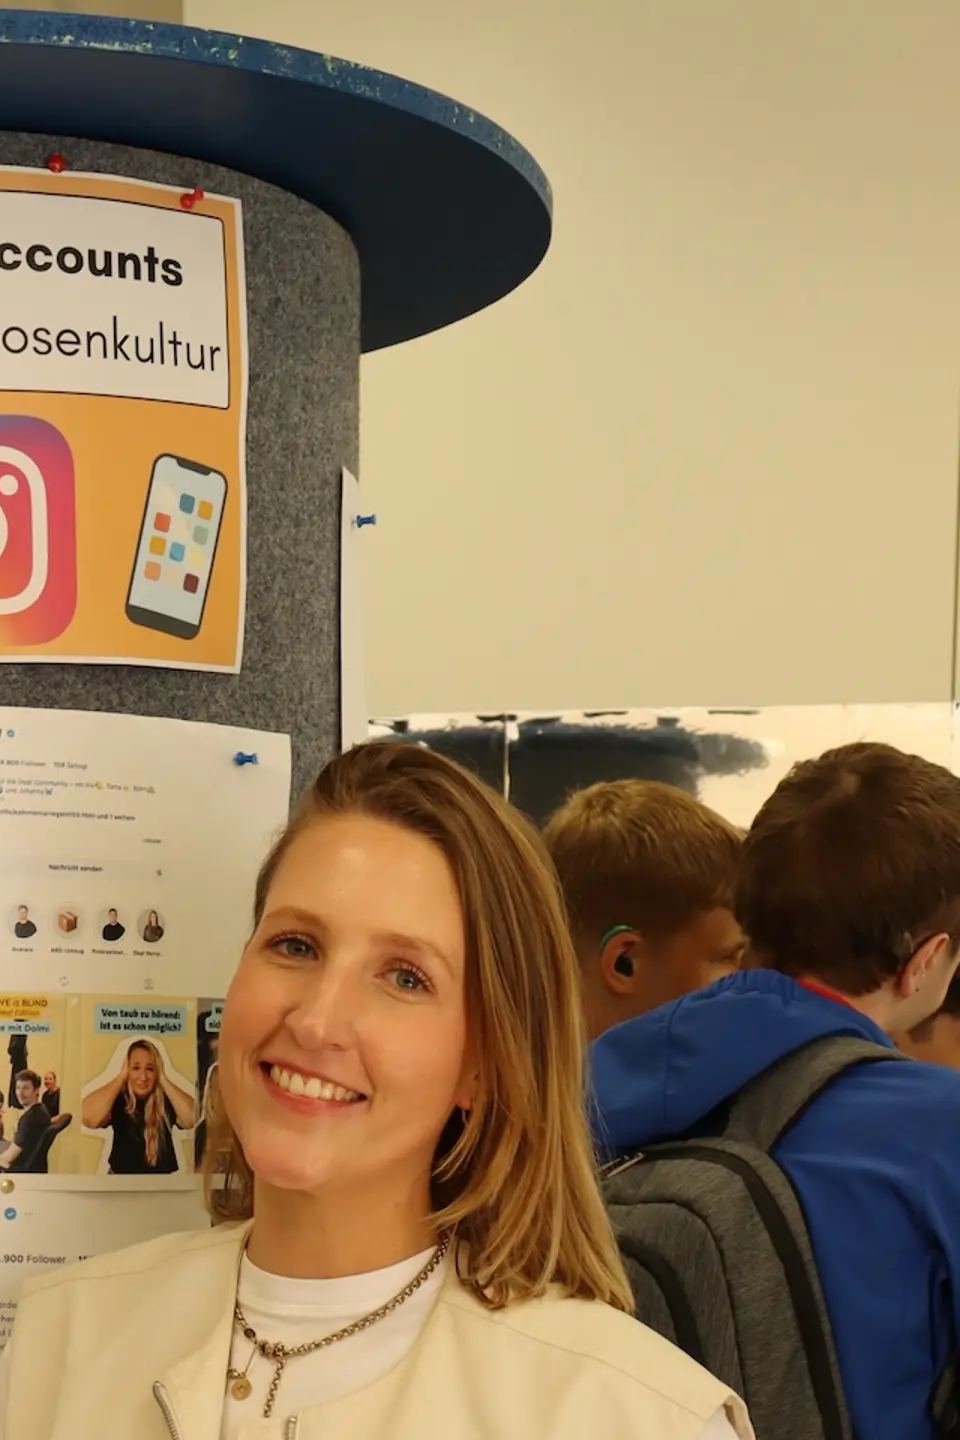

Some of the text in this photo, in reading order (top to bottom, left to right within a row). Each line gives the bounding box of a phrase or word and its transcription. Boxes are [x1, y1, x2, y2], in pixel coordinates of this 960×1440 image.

[22, 999, 48, 1007] BLIND
[102, 1009, 118, 1017] Von
[120, 1009, 139, 1018] taub
[100, 1022, 111, 1030] Ist
[124, 1022, 146, 1031] schon
[148, 1023, 182, 1034] möglich?
[26, 1255, 66, 1264] Follower
